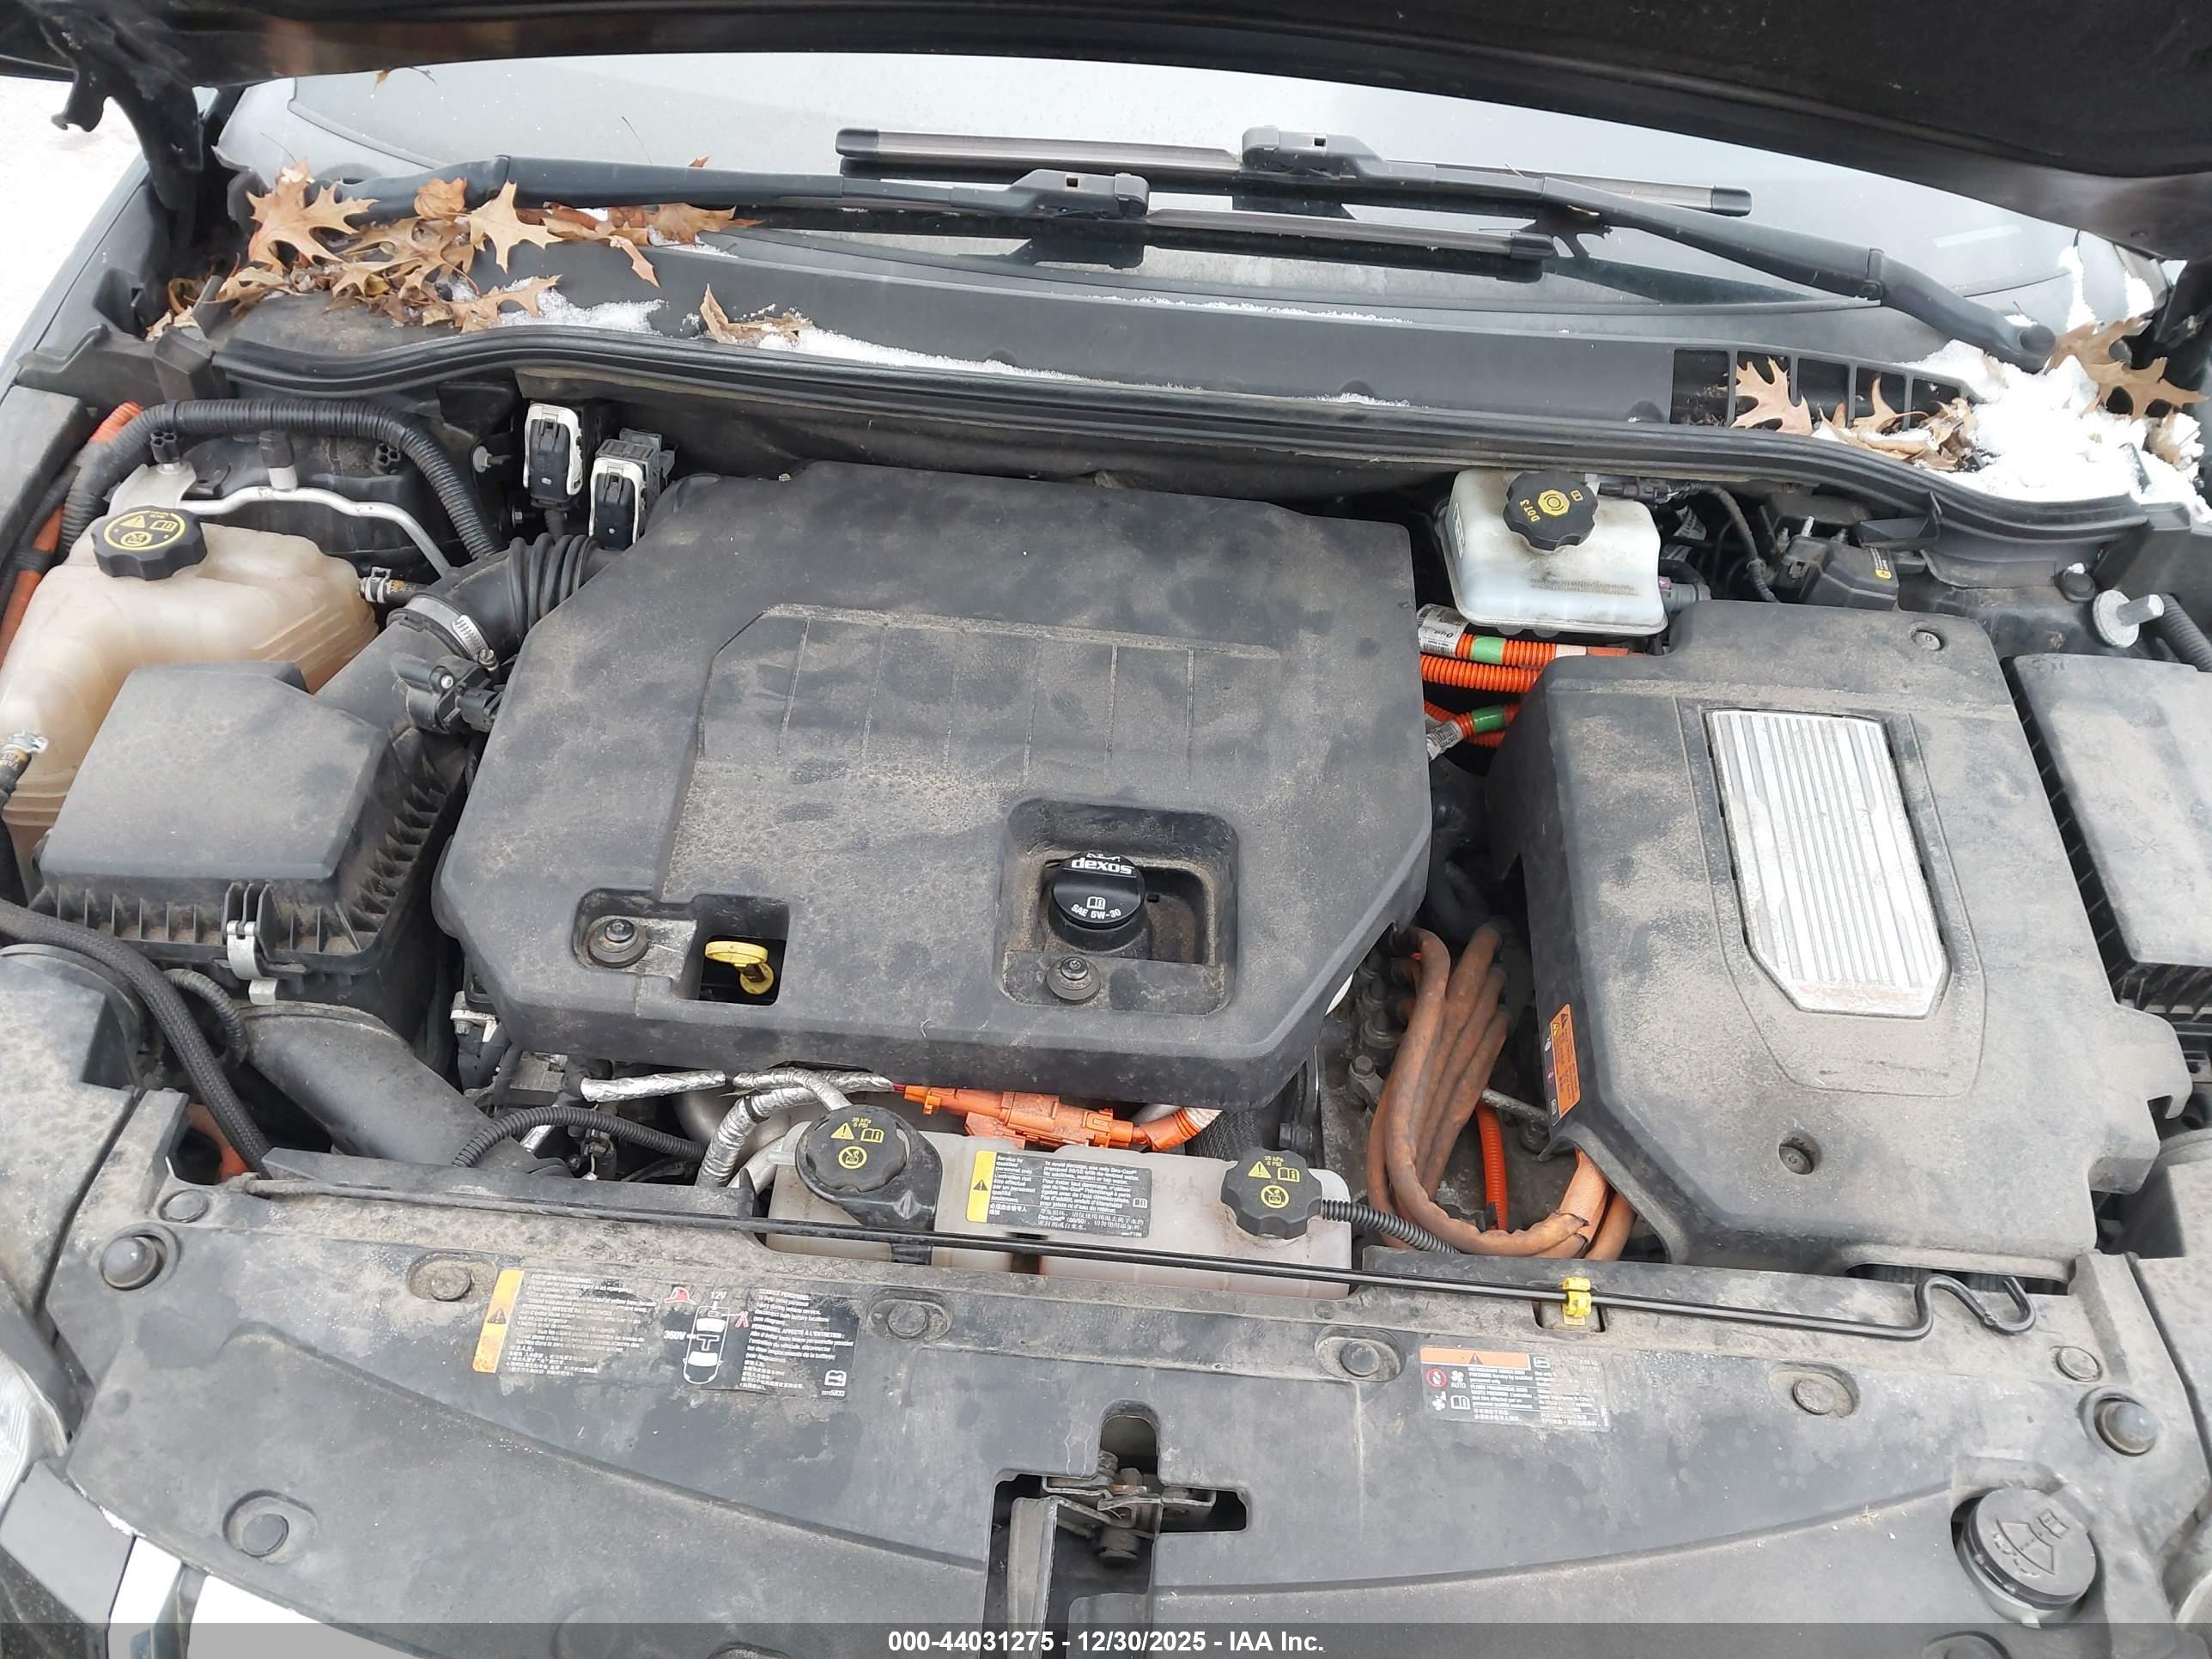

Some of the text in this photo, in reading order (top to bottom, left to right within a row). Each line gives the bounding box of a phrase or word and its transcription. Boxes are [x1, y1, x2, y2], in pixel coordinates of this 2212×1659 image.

[1072, 857, 1134, 874] dexos
[1071, 903, 1121, 920] SAE 5W-30
[710, 1291, 727, 1300] 12V
[663, 1330, 686, 1340] 360V
